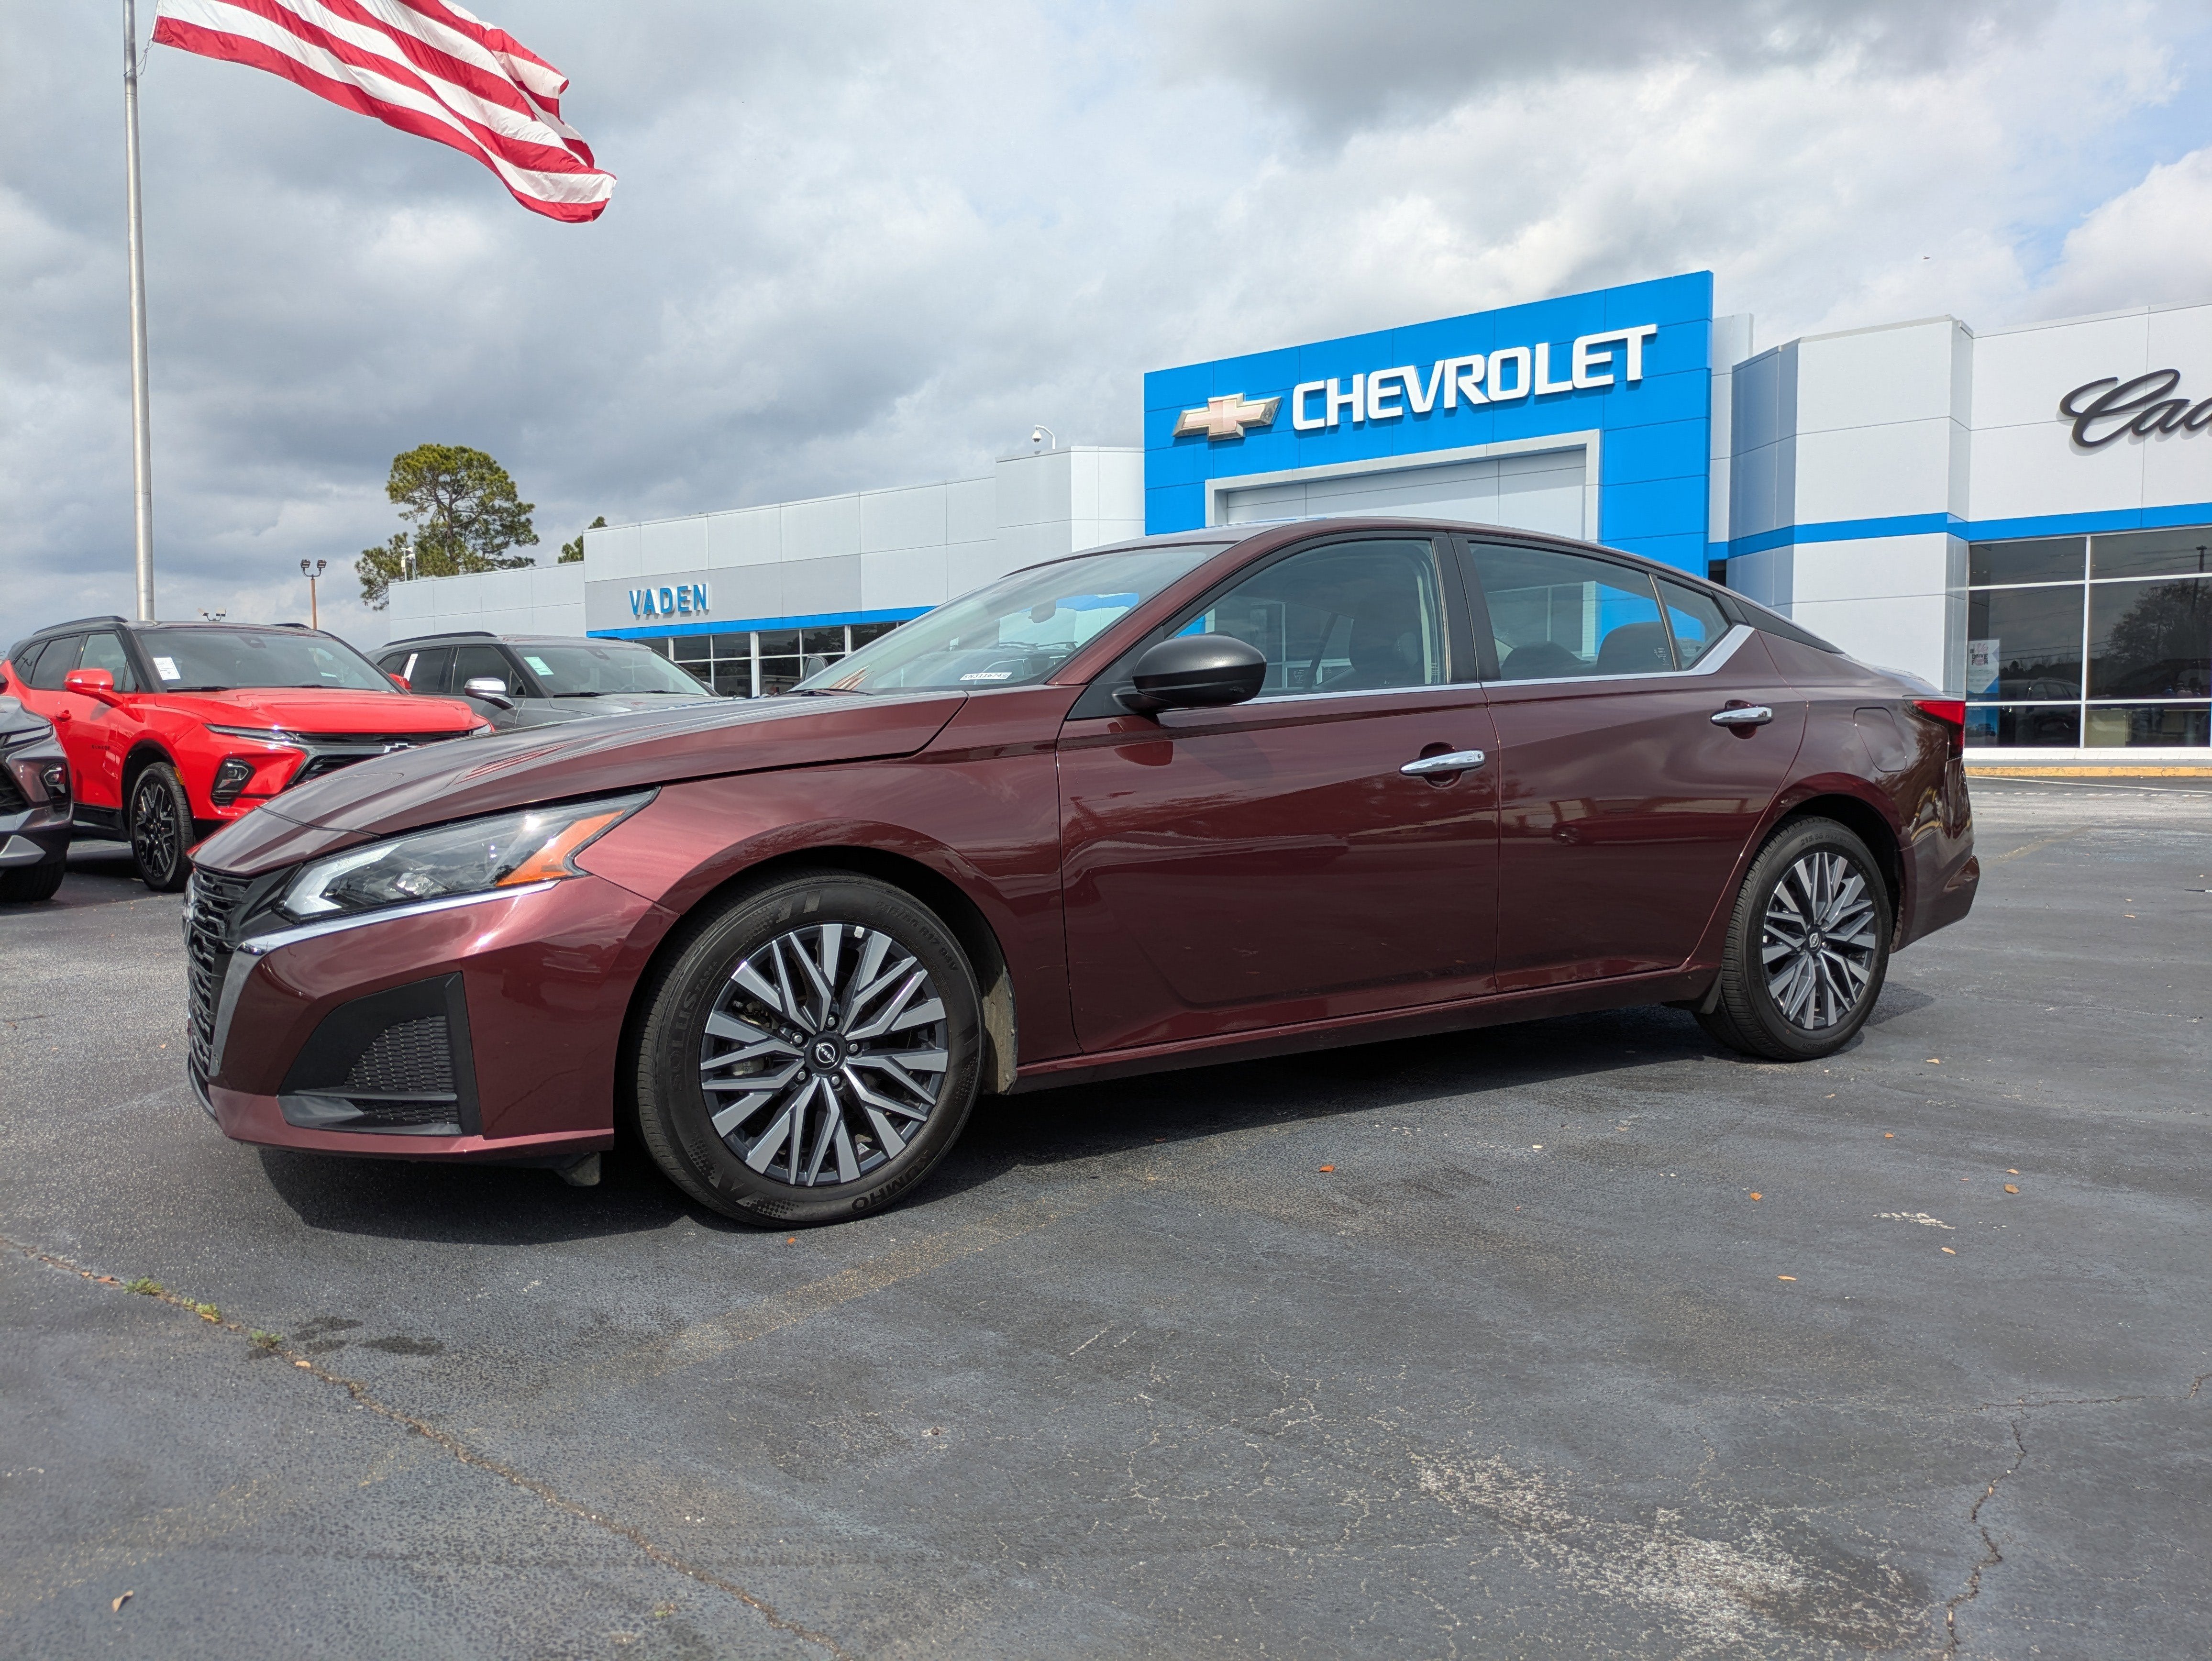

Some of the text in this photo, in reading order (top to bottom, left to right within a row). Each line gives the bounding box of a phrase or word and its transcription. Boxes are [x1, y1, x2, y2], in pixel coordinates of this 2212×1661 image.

[1292, 324, 1658, 431] CHEVROLET
[629, 584, 709, 616] VADEN
[669, 991, 697, 1092] SOLUS
[816, 1043, 835, 1063] NISSAN
[852, 1150, 929, 1210] KUMHO
